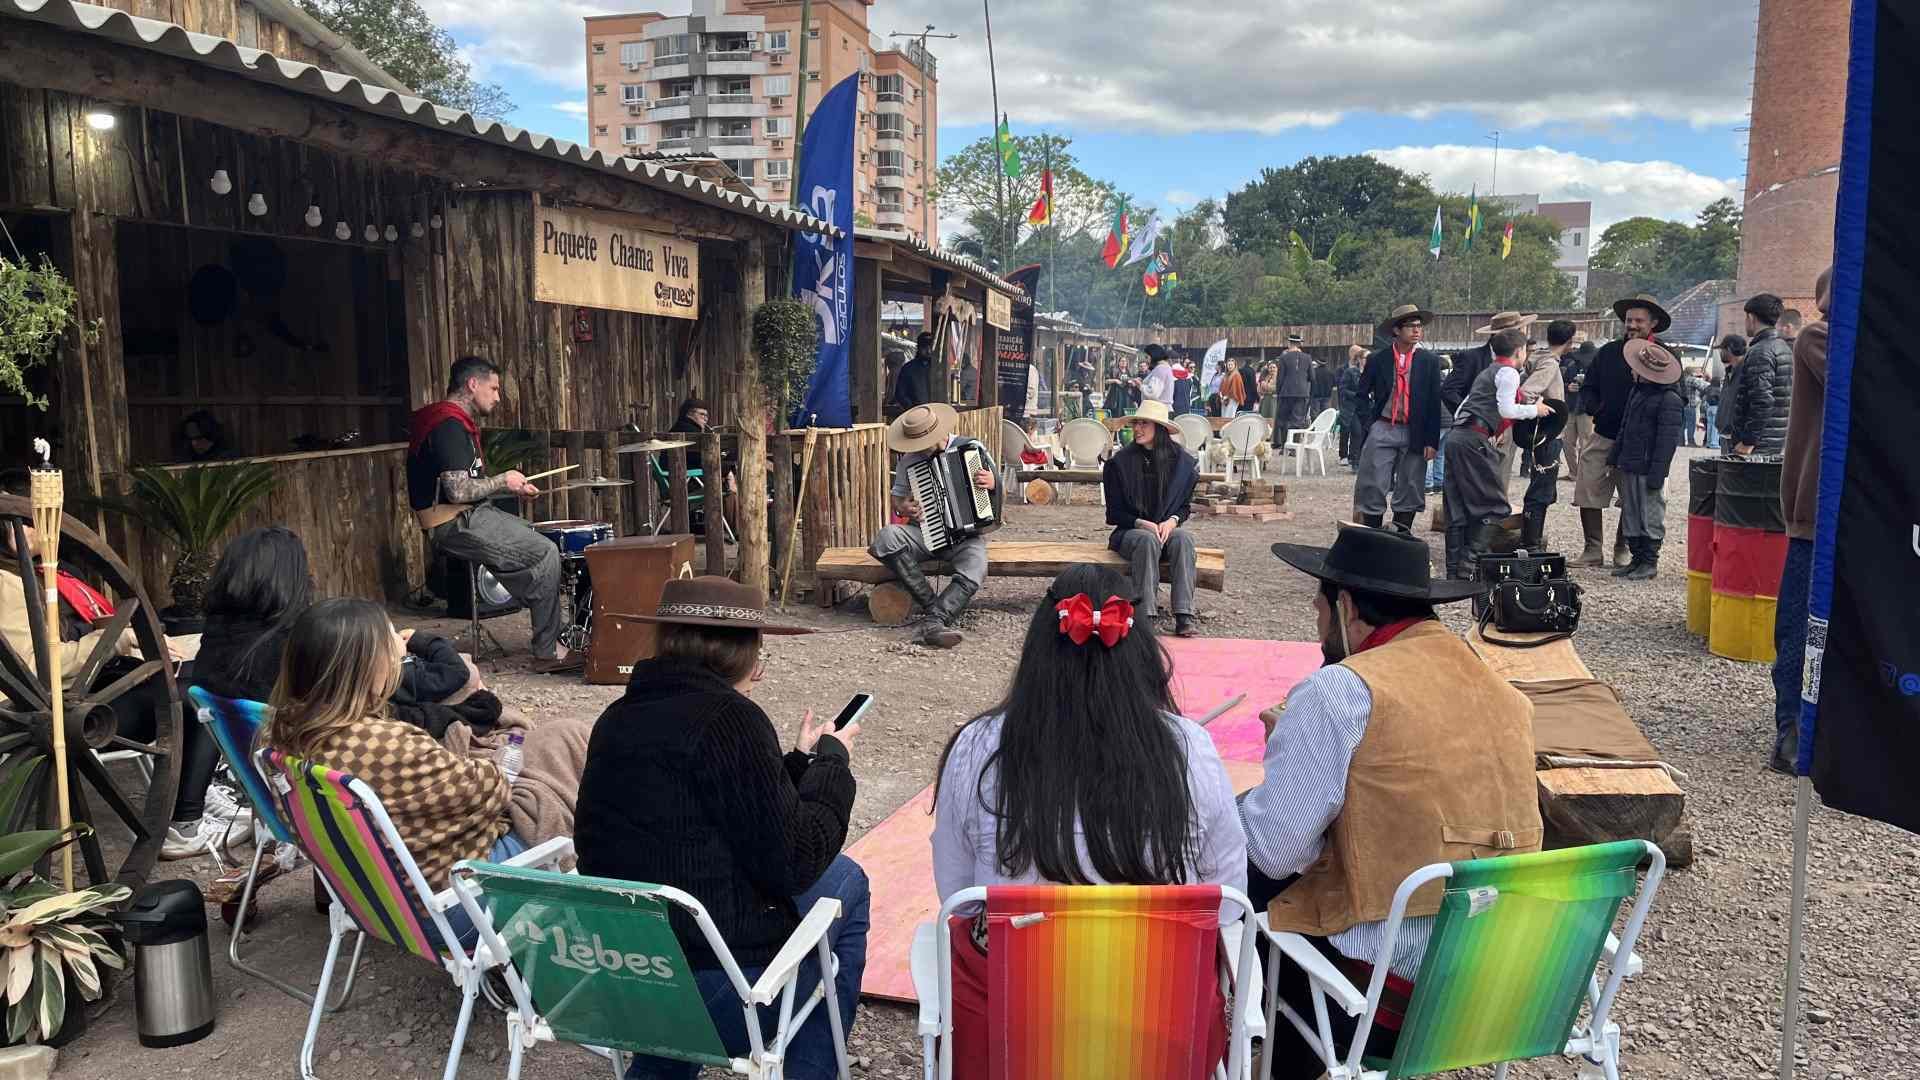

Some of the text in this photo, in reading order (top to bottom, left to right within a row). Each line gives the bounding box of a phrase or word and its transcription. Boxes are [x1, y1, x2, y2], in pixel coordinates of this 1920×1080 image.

[543, 221, 689, 279] Piquete Chama Viva
[654, 281, 695, 307] Connect
[550, 926, 674, 979] Lebes
